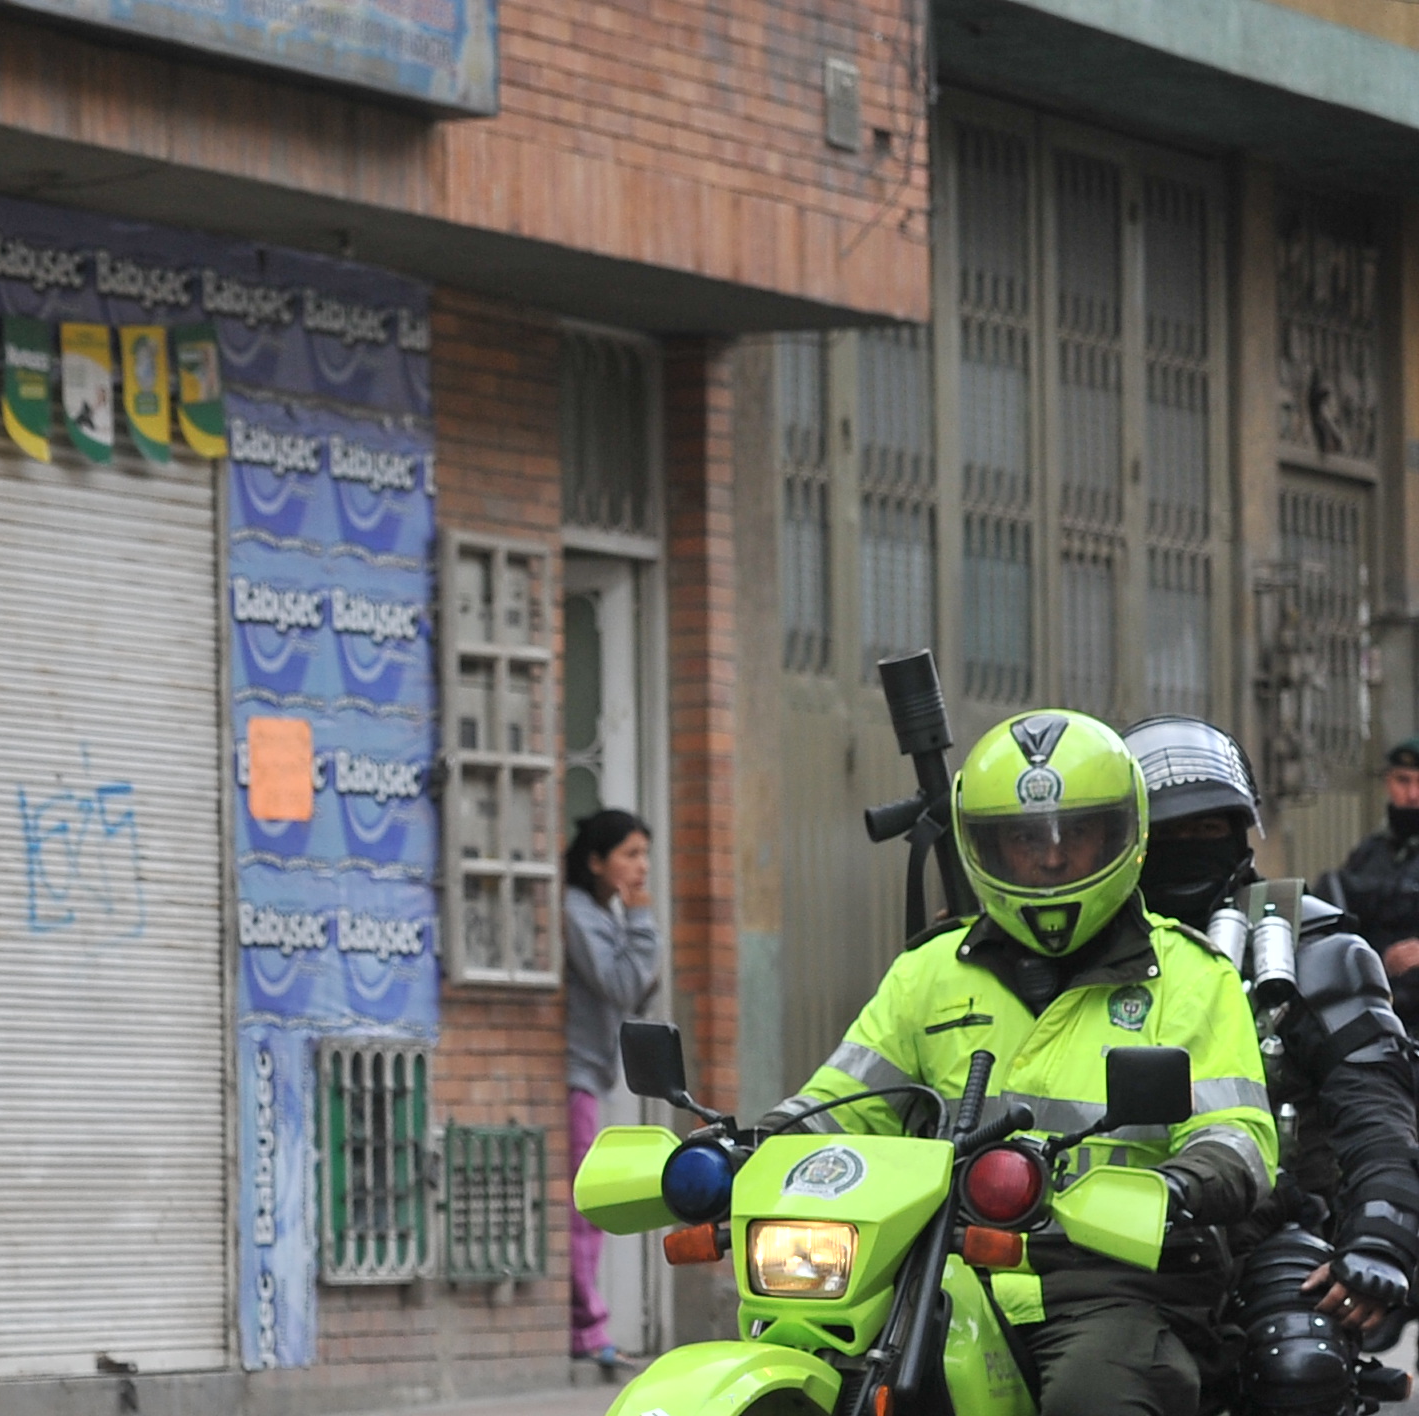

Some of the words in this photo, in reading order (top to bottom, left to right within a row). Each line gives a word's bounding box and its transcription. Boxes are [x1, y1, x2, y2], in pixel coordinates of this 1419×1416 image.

[95, 250, 192, 309] Babysec
[202, 269, 296, 325] Babysec
[303, 290, 393, 343] Babysec
[230, 418, 322, 476] Babysec
[329, 433, 417, 493] Babysec
[233, 576, 324, 634] Babysec
[331, 588, 419, 645] Babysec
[335, 750, 423, 804] Babysec
[239, 903, 329, 957] Babysec
[336, 909, 424, 961] Babysec
[254, 1051, 275, 1246] Babysec
